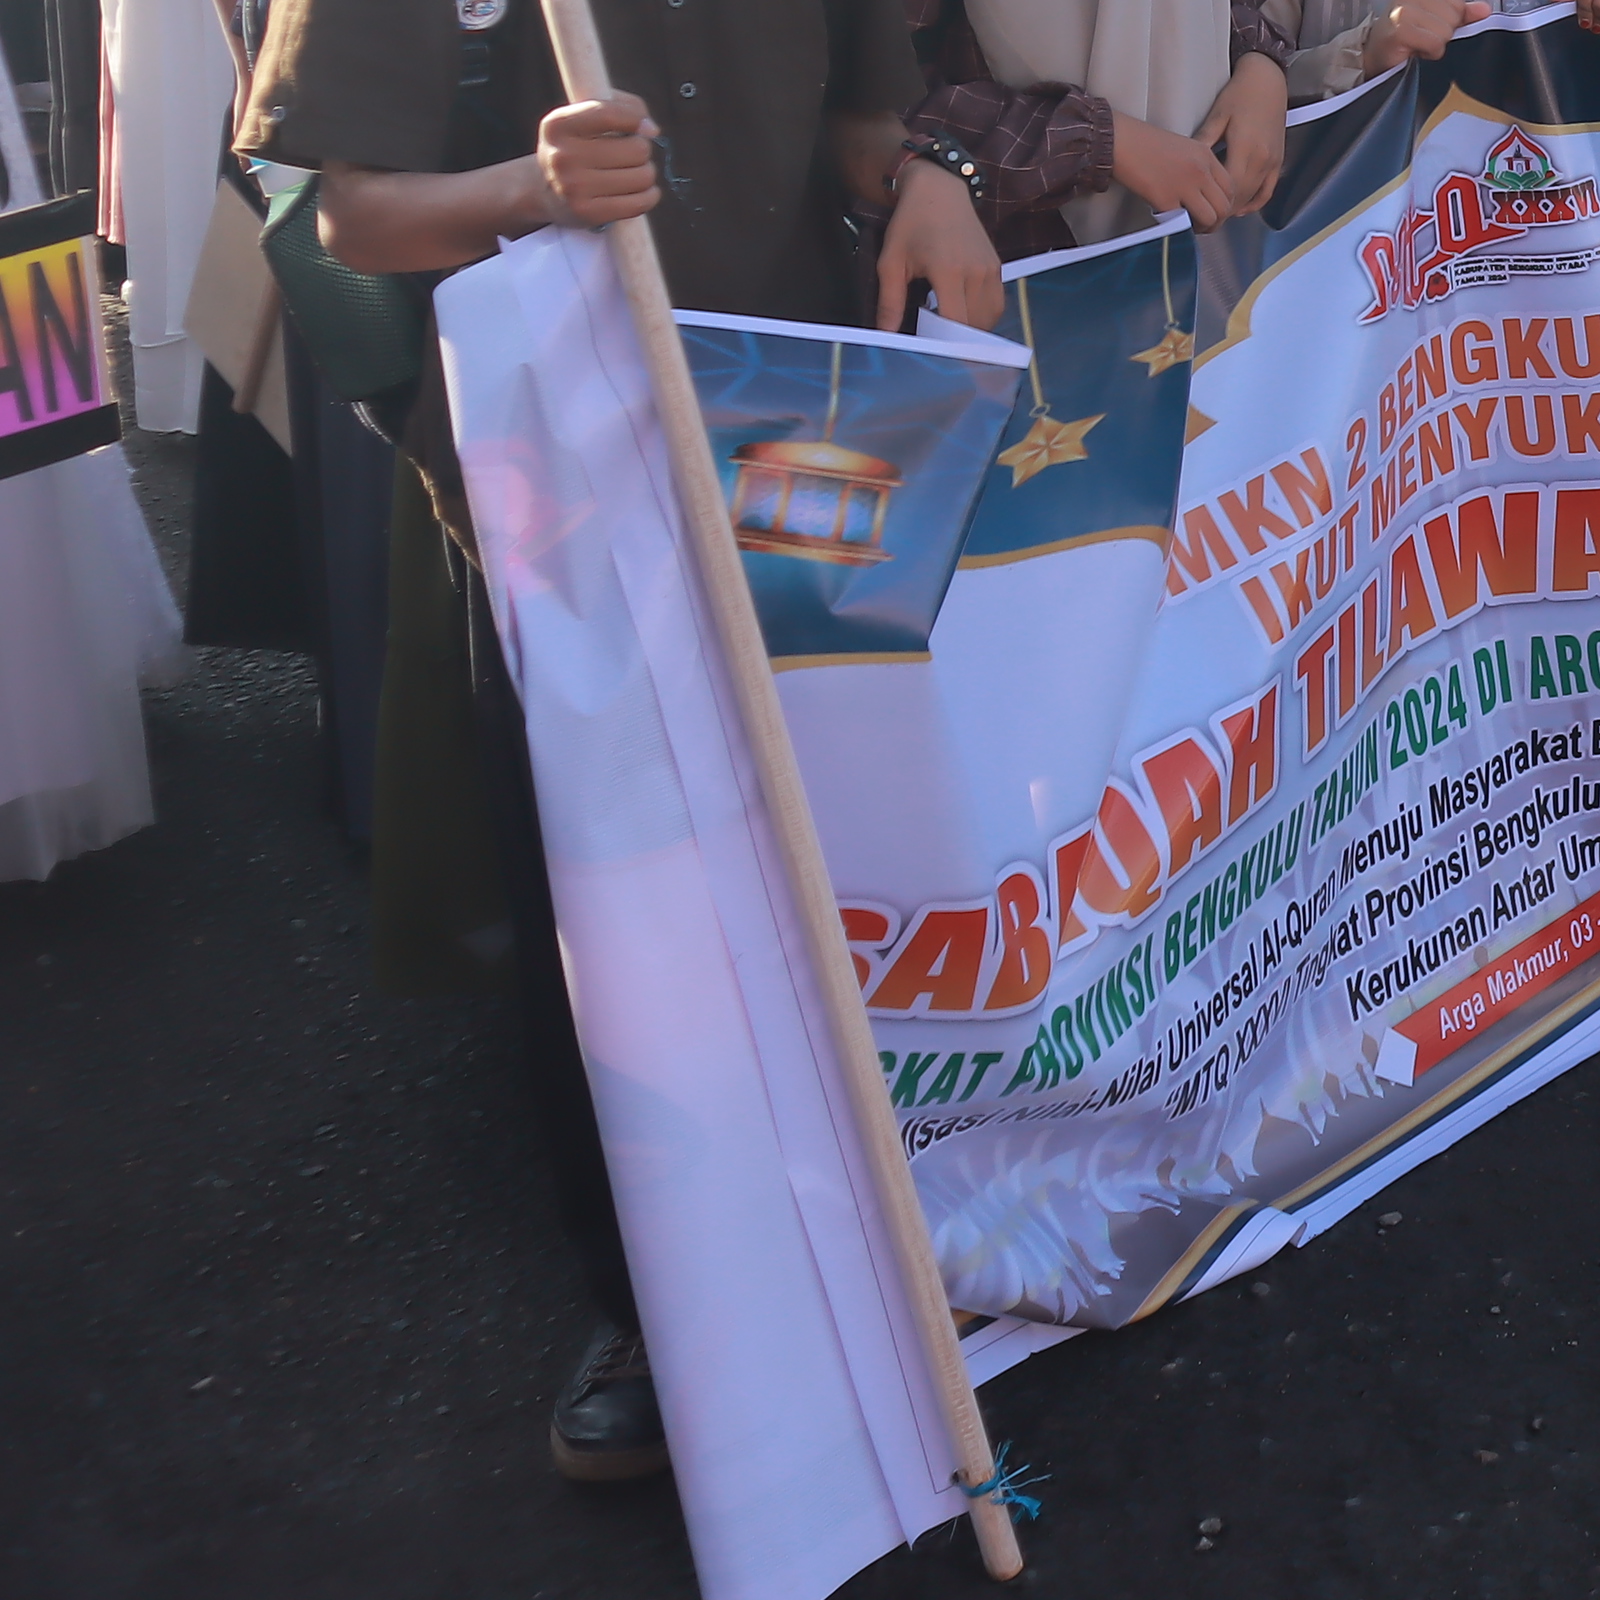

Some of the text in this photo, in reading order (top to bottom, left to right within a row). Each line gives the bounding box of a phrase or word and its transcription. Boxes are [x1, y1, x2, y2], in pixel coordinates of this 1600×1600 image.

[1455, 275, 1486, 287] TAHUN
[1556, 260, 1586, 270] UTARA
[1345, 417, 1367, 493] 2
[1239, 501, 1360, 646] IKUT
[998, 931, 1156, 1098] PROVINSI
[1163, 800, 1306, 986] BENGKULU
[1309, 719, 1380, 848] TAHUN
[1387, 664, 1468, 771] 2024
[1472, 639, 1512, 718] DI
[1167, 942, 1259, 1073] Universal
[1262, 869, 1337, 981] Al-Quran
[1340, 802, 1424, 891] Menuju
[1428, 720, 1582, 829] Masyarakat
[1345, 905, 1489, 1023] Kerukunan
[1492, 858, 1556, 932] Antar
[1233, 972, 1292, 1077] XXXVI
[1294, 903, 1364, 1003] Tingkat
[1364, 833, 1470, 938] Provinsi
[1439, 994, 1486, 1040] Arga
[1487, 937, 1570, 1008] Makmur,
[1569, 912, 1594, 951] 03
